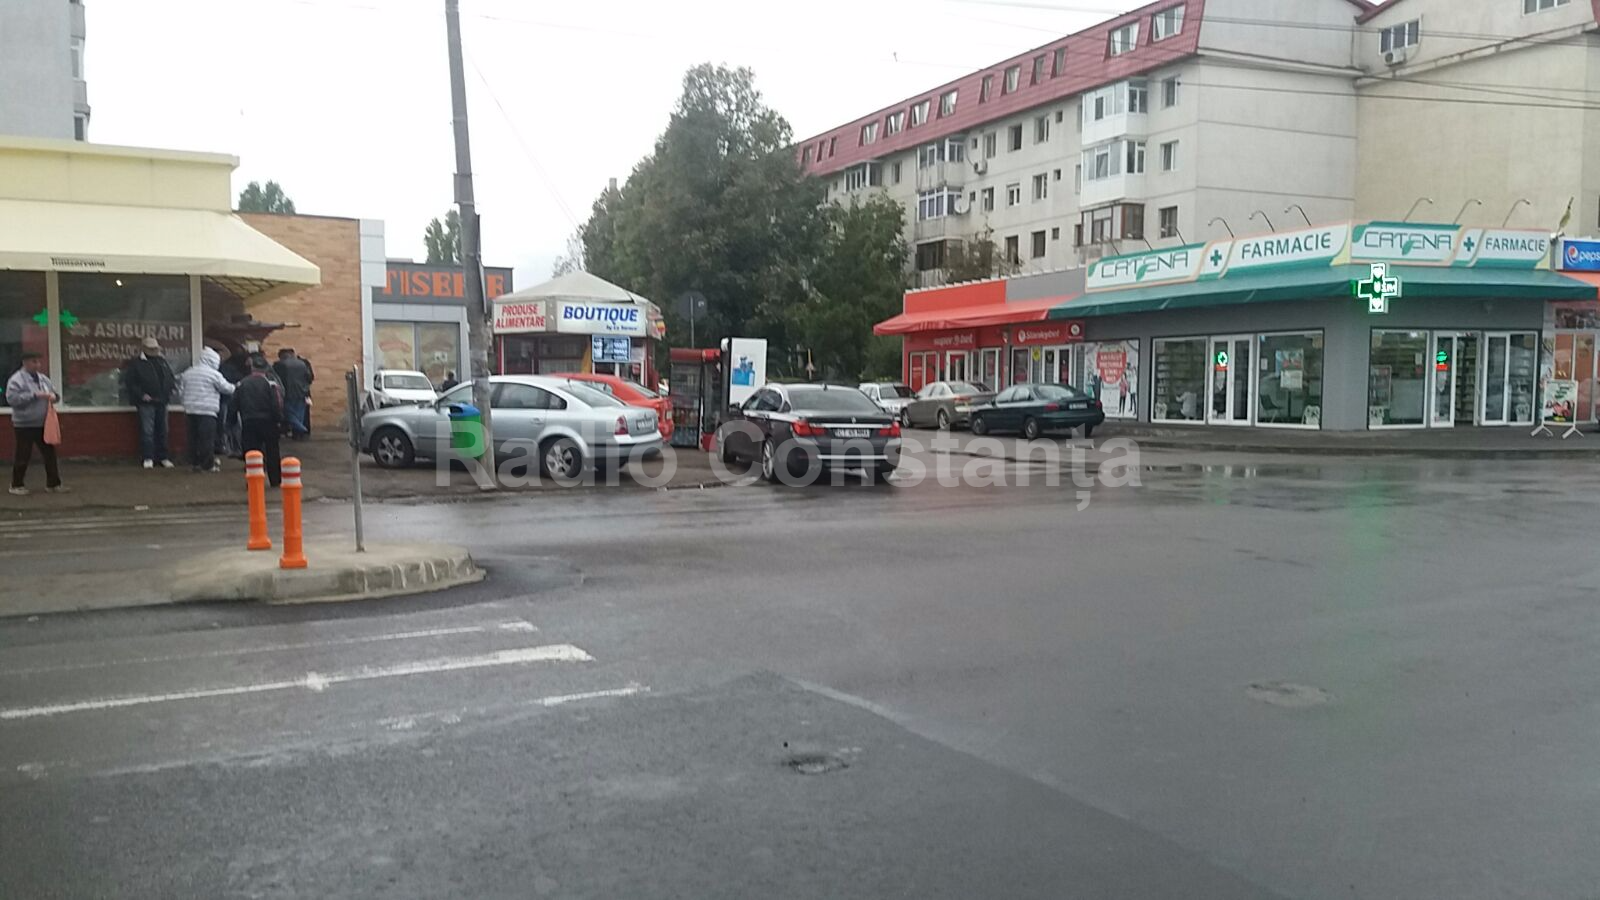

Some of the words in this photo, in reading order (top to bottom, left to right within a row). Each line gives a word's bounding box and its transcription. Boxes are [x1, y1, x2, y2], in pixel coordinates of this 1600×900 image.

[1364, 231, 1452, 254] CATENA
[1485, 236, 1546, 252] FARMACIE
[1101, 250, 1189, 281] CATENA
[1241, 232, 1332, 260] FARMACIE
[501, 303, 539, 317] PRODUSE
[563, 305, 639, 326] BOUTIQUE
[94, 322, 185, 340] ASIGURARI
[495, 316, 545, 330] ALIMENTARE
